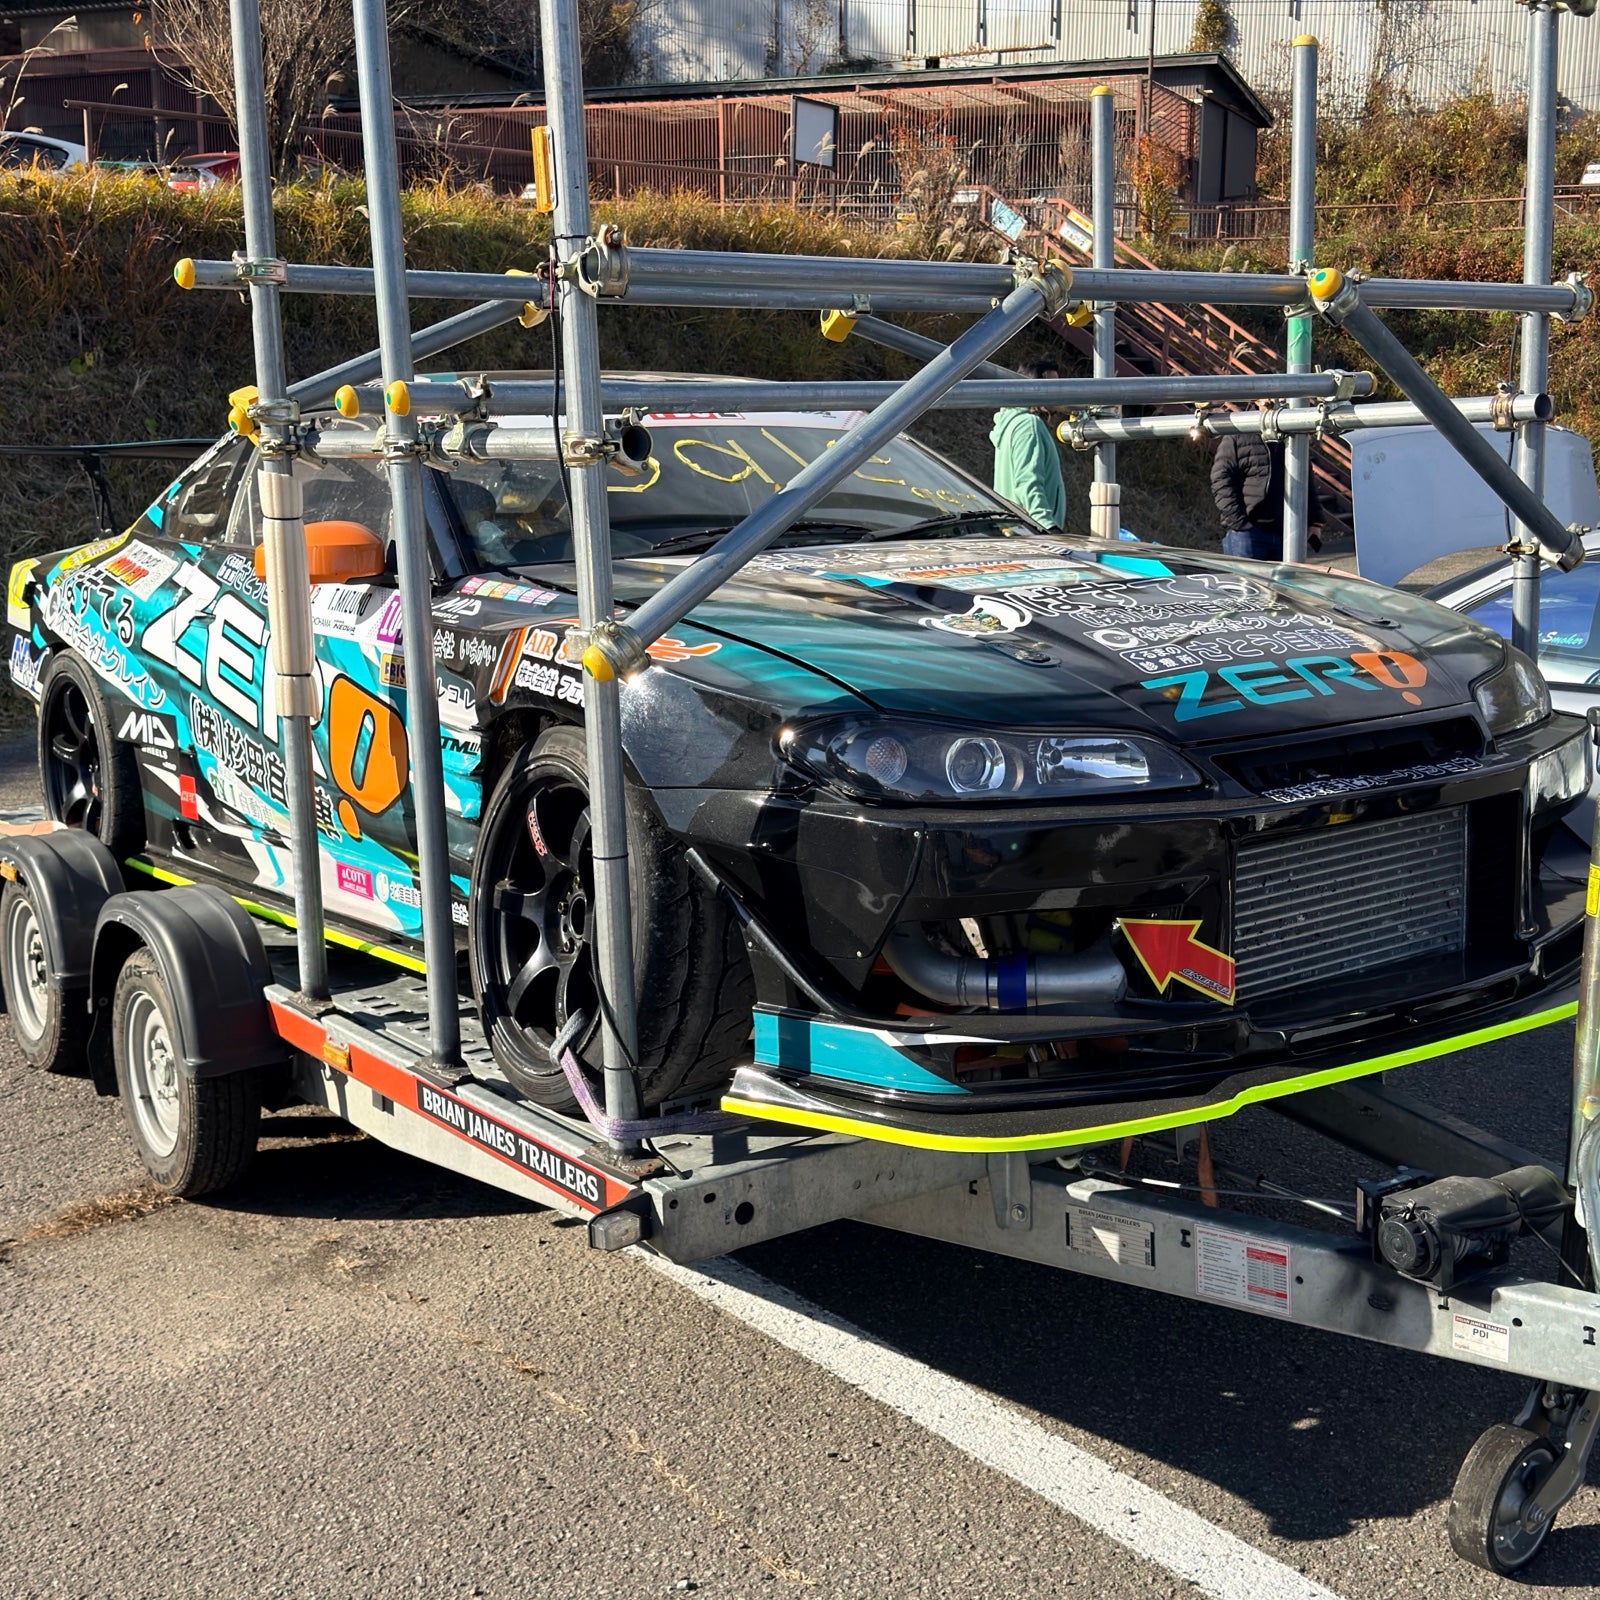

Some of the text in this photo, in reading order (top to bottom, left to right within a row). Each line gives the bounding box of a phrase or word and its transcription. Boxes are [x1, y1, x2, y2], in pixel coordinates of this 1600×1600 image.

[523, 630, 557, 660] AIR
[1129, 646, 1181, 661] くるまの
[189, 692, 344, 843] (株)杉田自車
[422, 1086, 600, 1203] BRIAN JAMES TRAILERS
[1078, 1208, 1141, 1228] BRIAN JAMES TRAILERS
[1472, 1328, 1489, 1339] PDI
